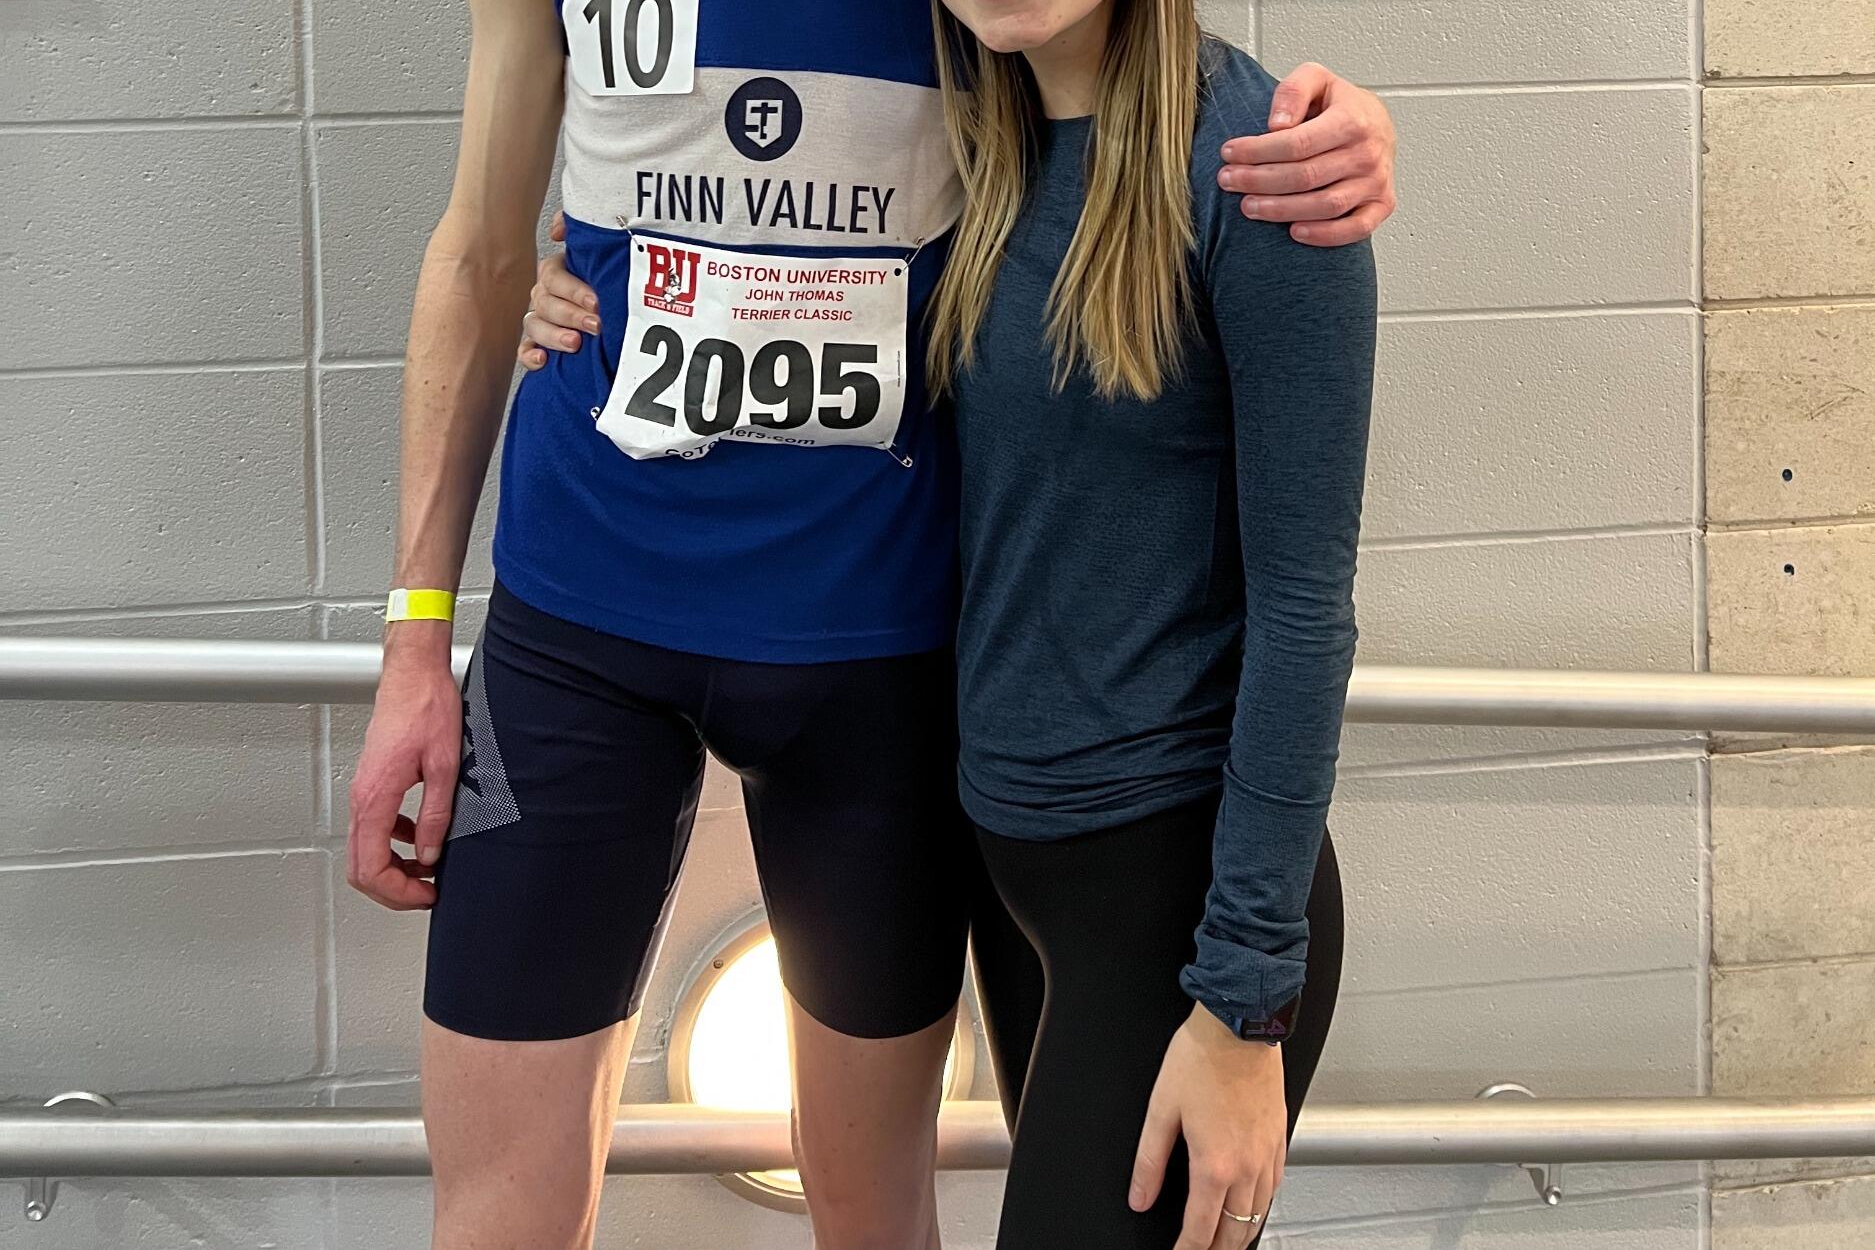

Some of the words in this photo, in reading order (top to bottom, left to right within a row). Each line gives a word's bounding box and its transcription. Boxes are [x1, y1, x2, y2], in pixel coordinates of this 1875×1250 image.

[637, 171, 724, 224] FINN
[744, 178, 895, 234] VALLEY
[644, 243, 701, 303] BU
[707, 261, 780, 283] BOSTON
[787, 269, 887, 285] UNIVERSITY
[731, 307, 790, 320] TERRIER
[794, 309, 853, 321] CLASSIC
[745, 288, 784, 301] JOHN
[789, 290, 844, 302] THOMAS
[624, 324, 881, 437] 2095
